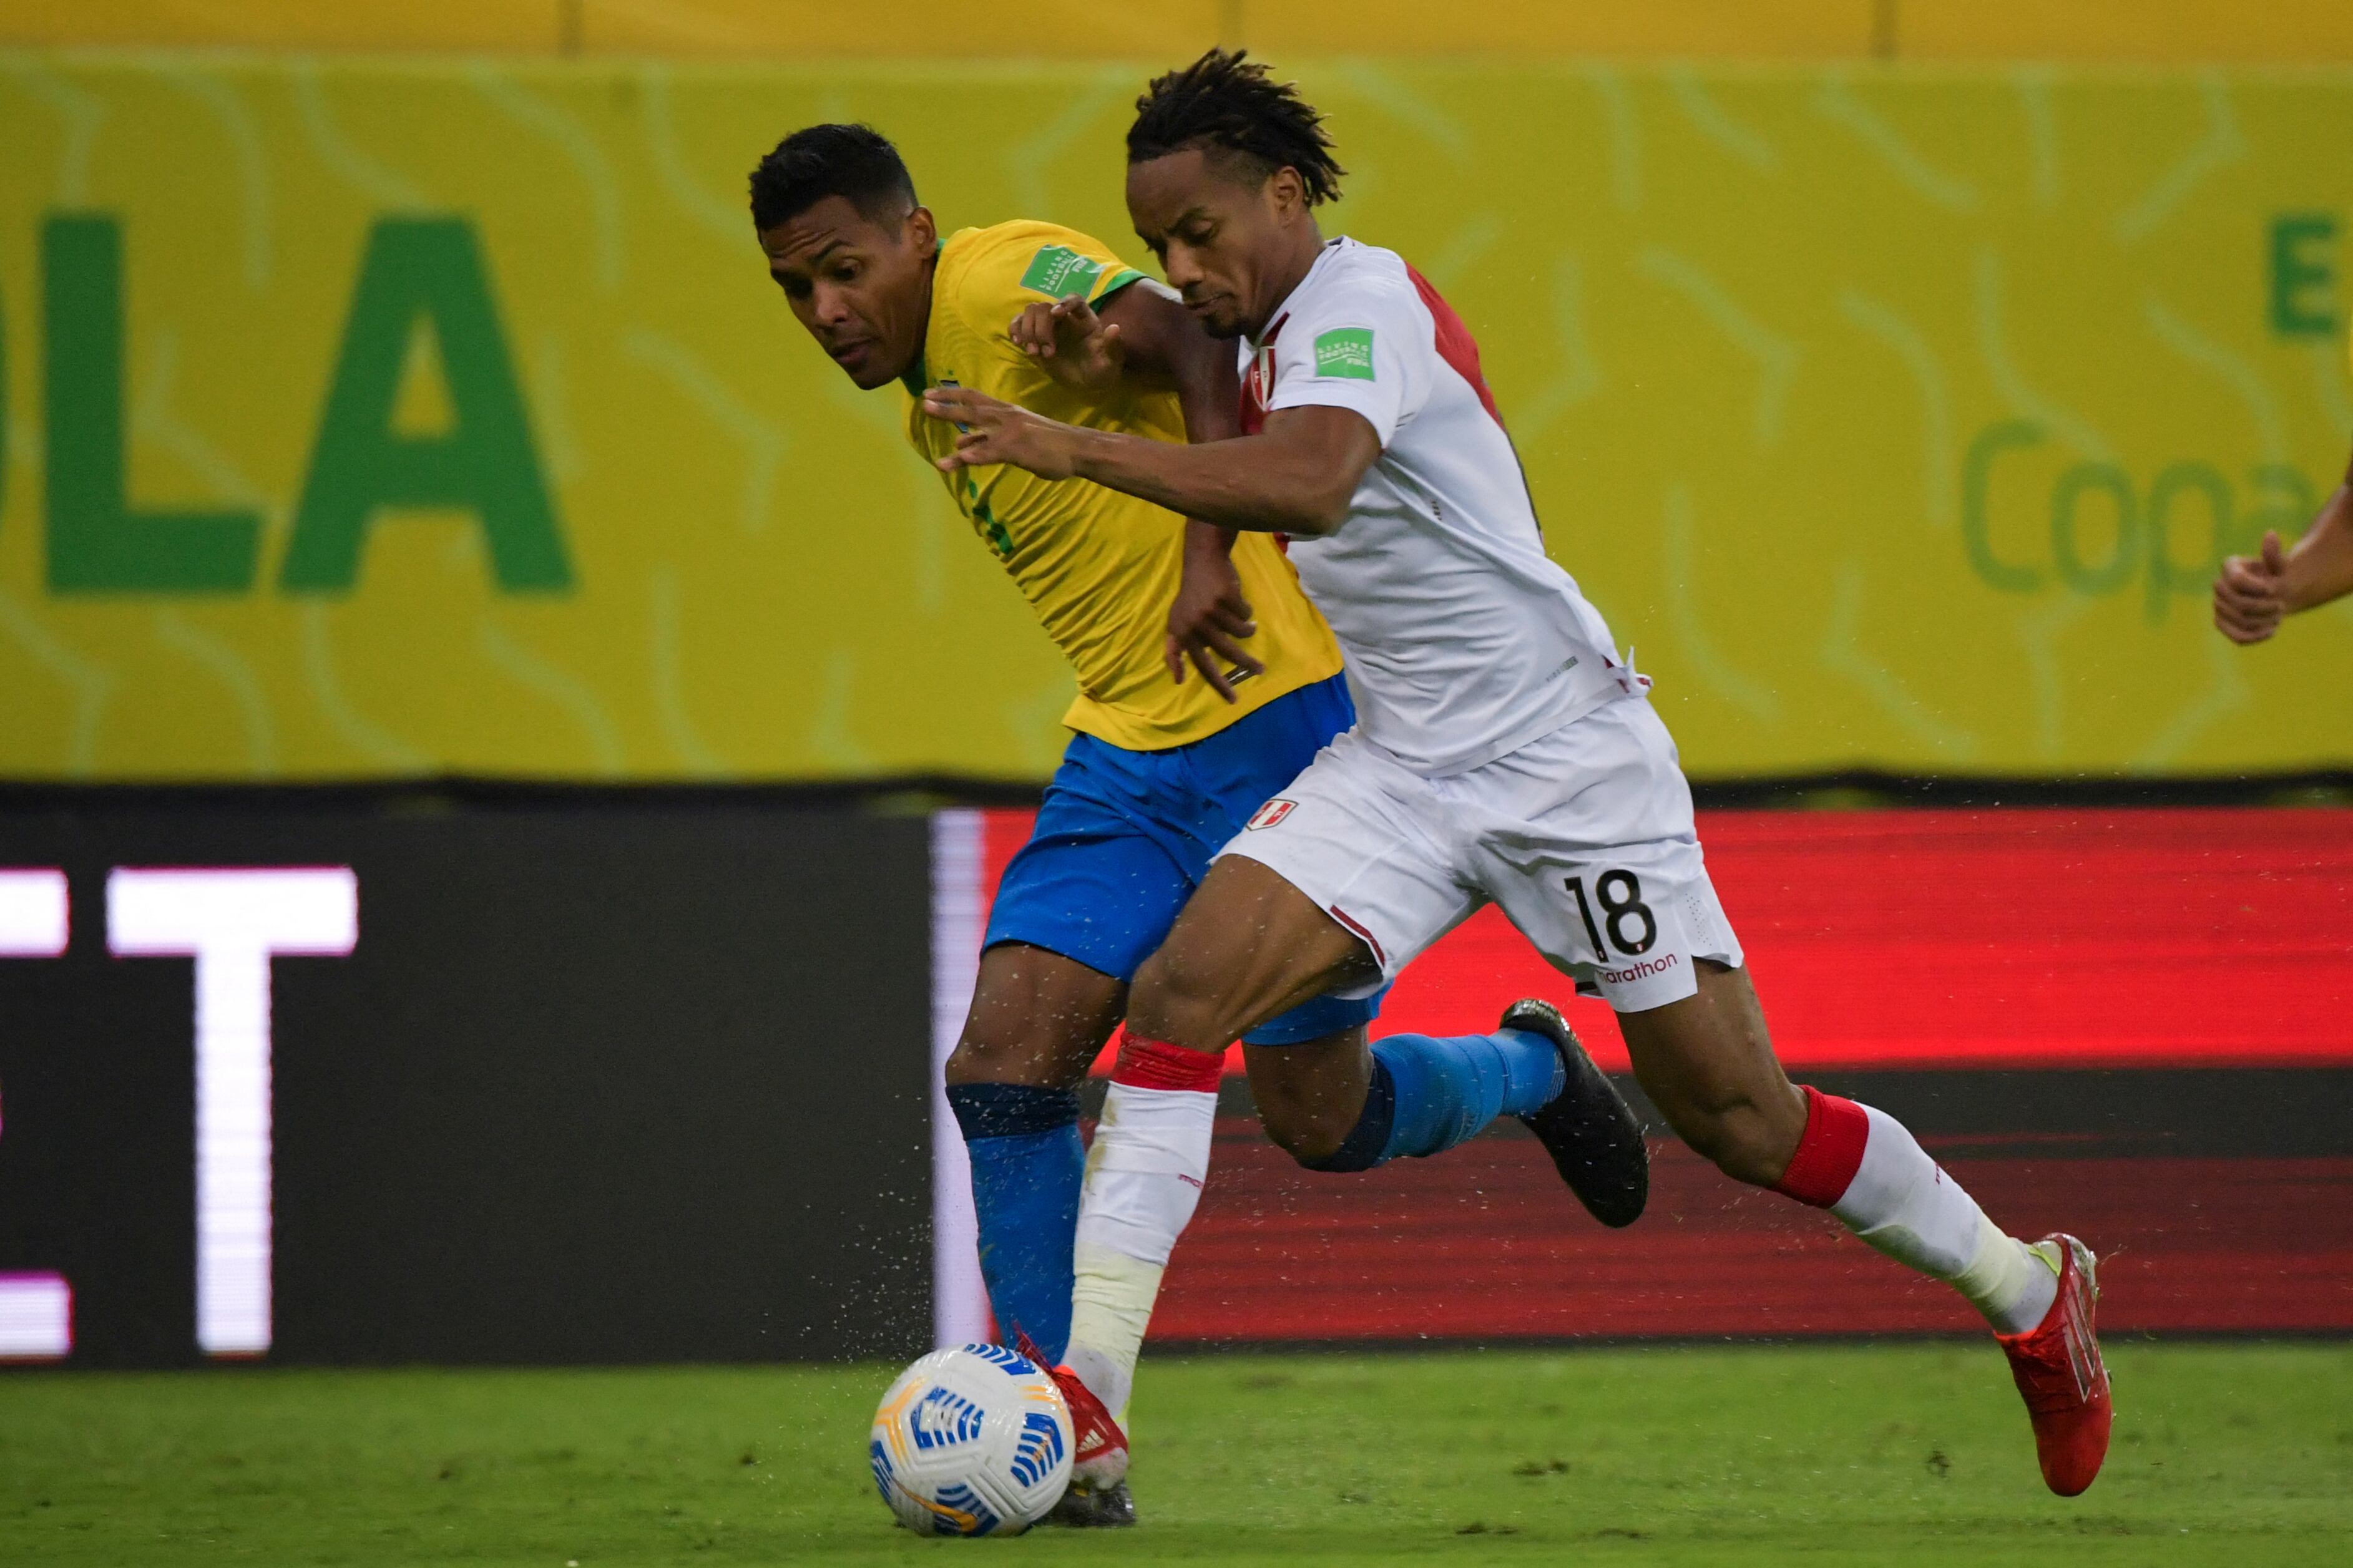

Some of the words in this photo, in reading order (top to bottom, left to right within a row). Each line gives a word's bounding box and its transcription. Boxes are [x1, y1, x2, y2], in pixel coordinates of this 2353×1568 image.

[1039, 250, 1068, 289] LIVING
[0, 215, 575, 594] LA
[1563, 869, 1657, 963] 18
